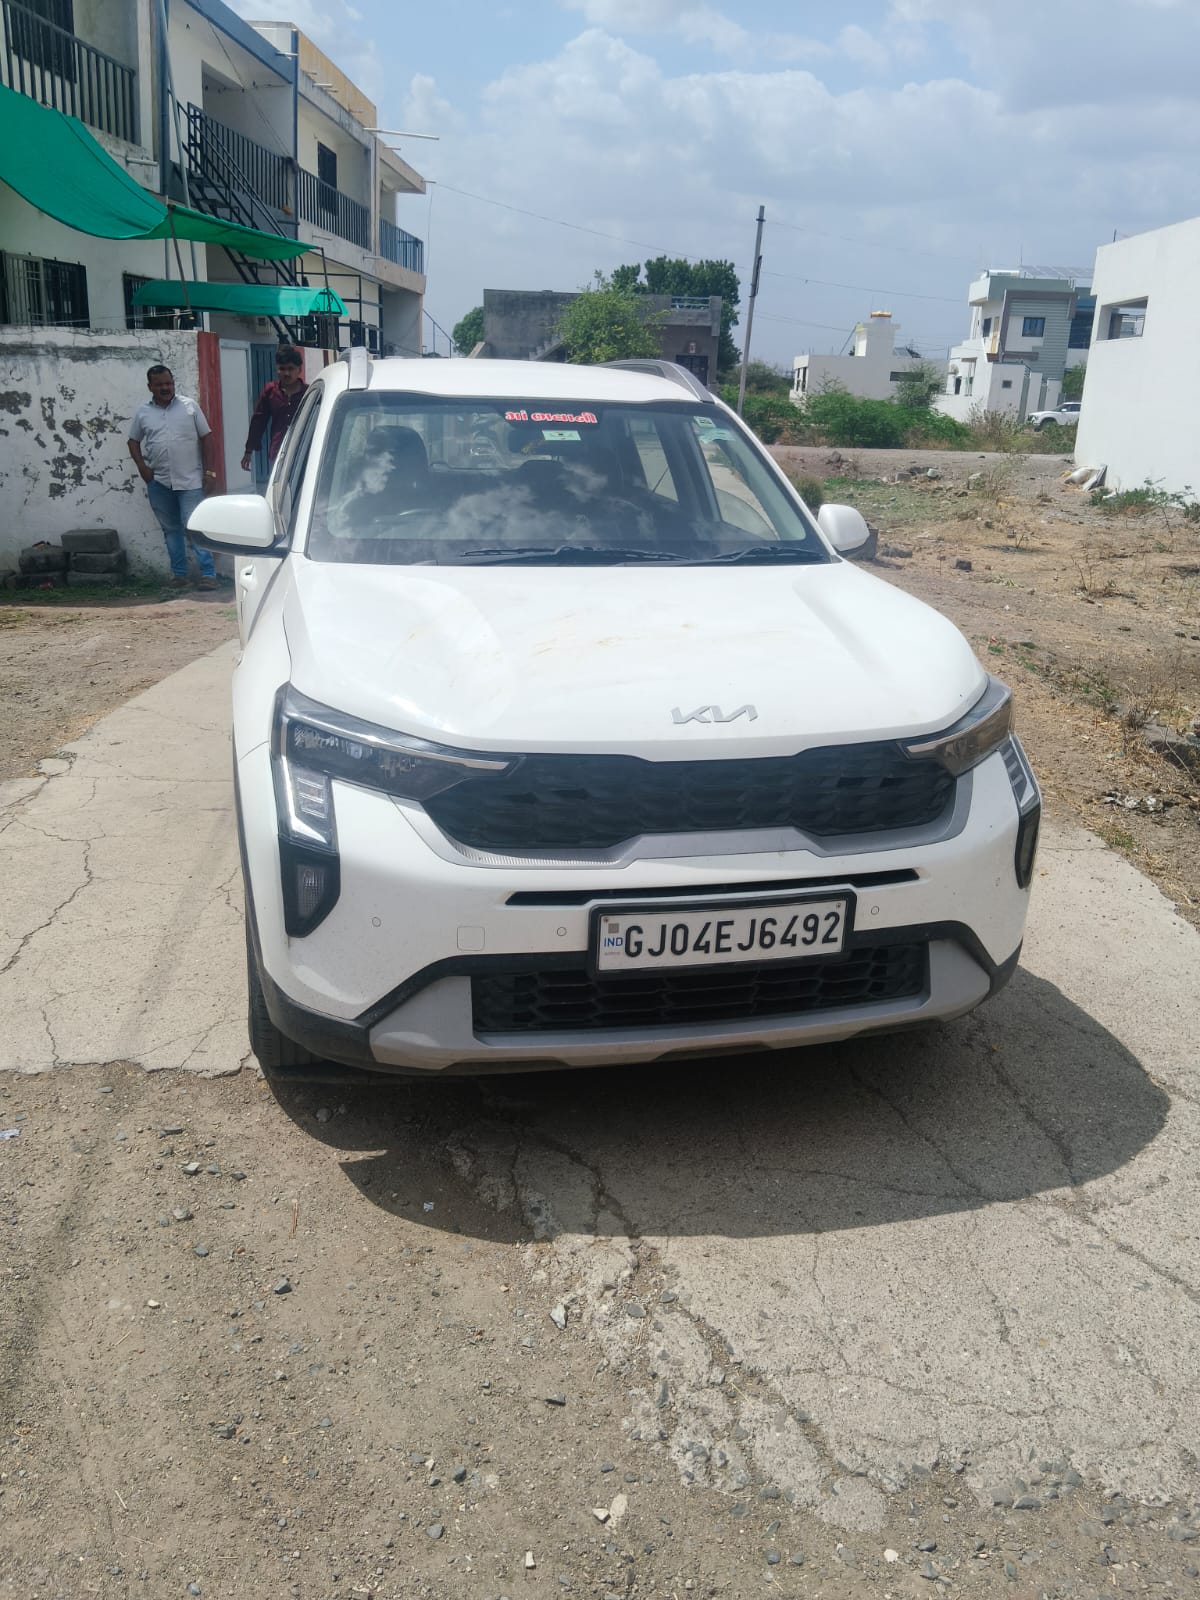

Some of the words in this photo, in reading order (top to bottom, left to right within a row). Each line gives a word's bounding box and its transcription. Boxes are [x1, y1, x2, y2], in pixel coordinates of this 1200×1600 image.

[671, 704, 758, 724] KIA
[603, 936, 623, 947] IND
[624, 911, 840, 958] GJ04EJ6492
